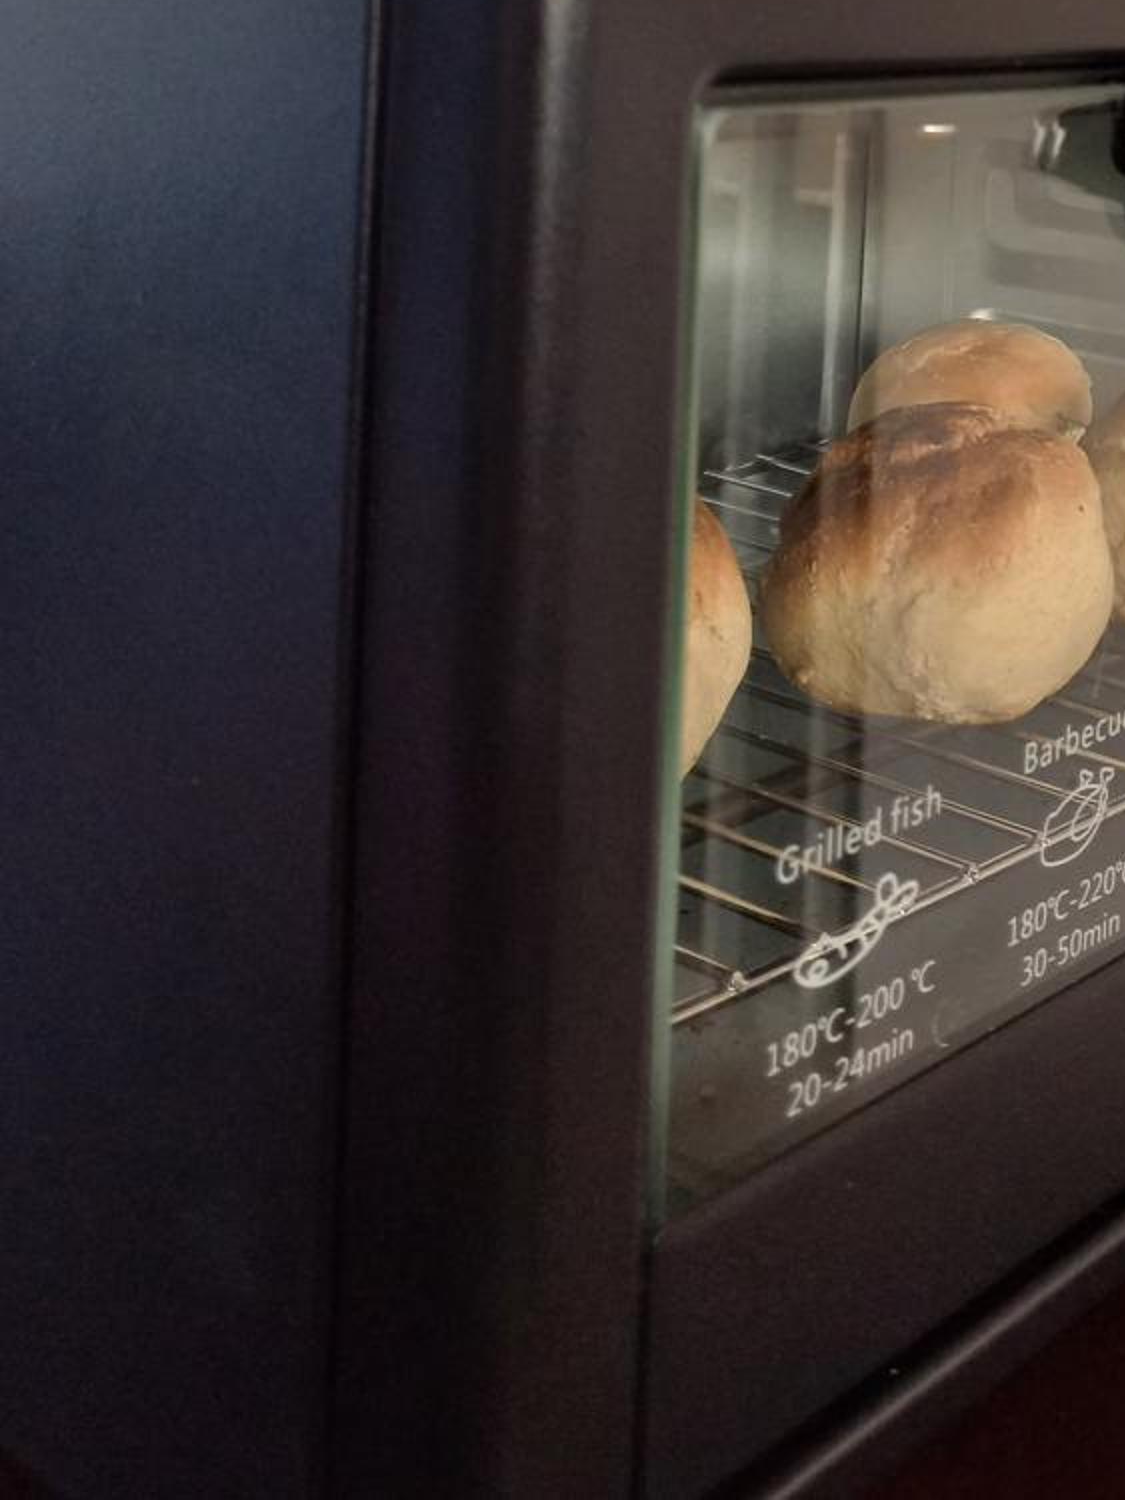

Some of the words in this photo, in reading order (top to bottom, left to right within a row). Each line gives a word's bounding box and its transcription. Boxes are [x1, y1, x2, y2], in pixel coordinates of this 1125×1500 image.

[775, 811, 884, 886] Grilled
[890, 784, 942, 835] fish
[1018, 912, 1121, 987] 30-50min
[786, 1027, 914, 1119] 20-24min
